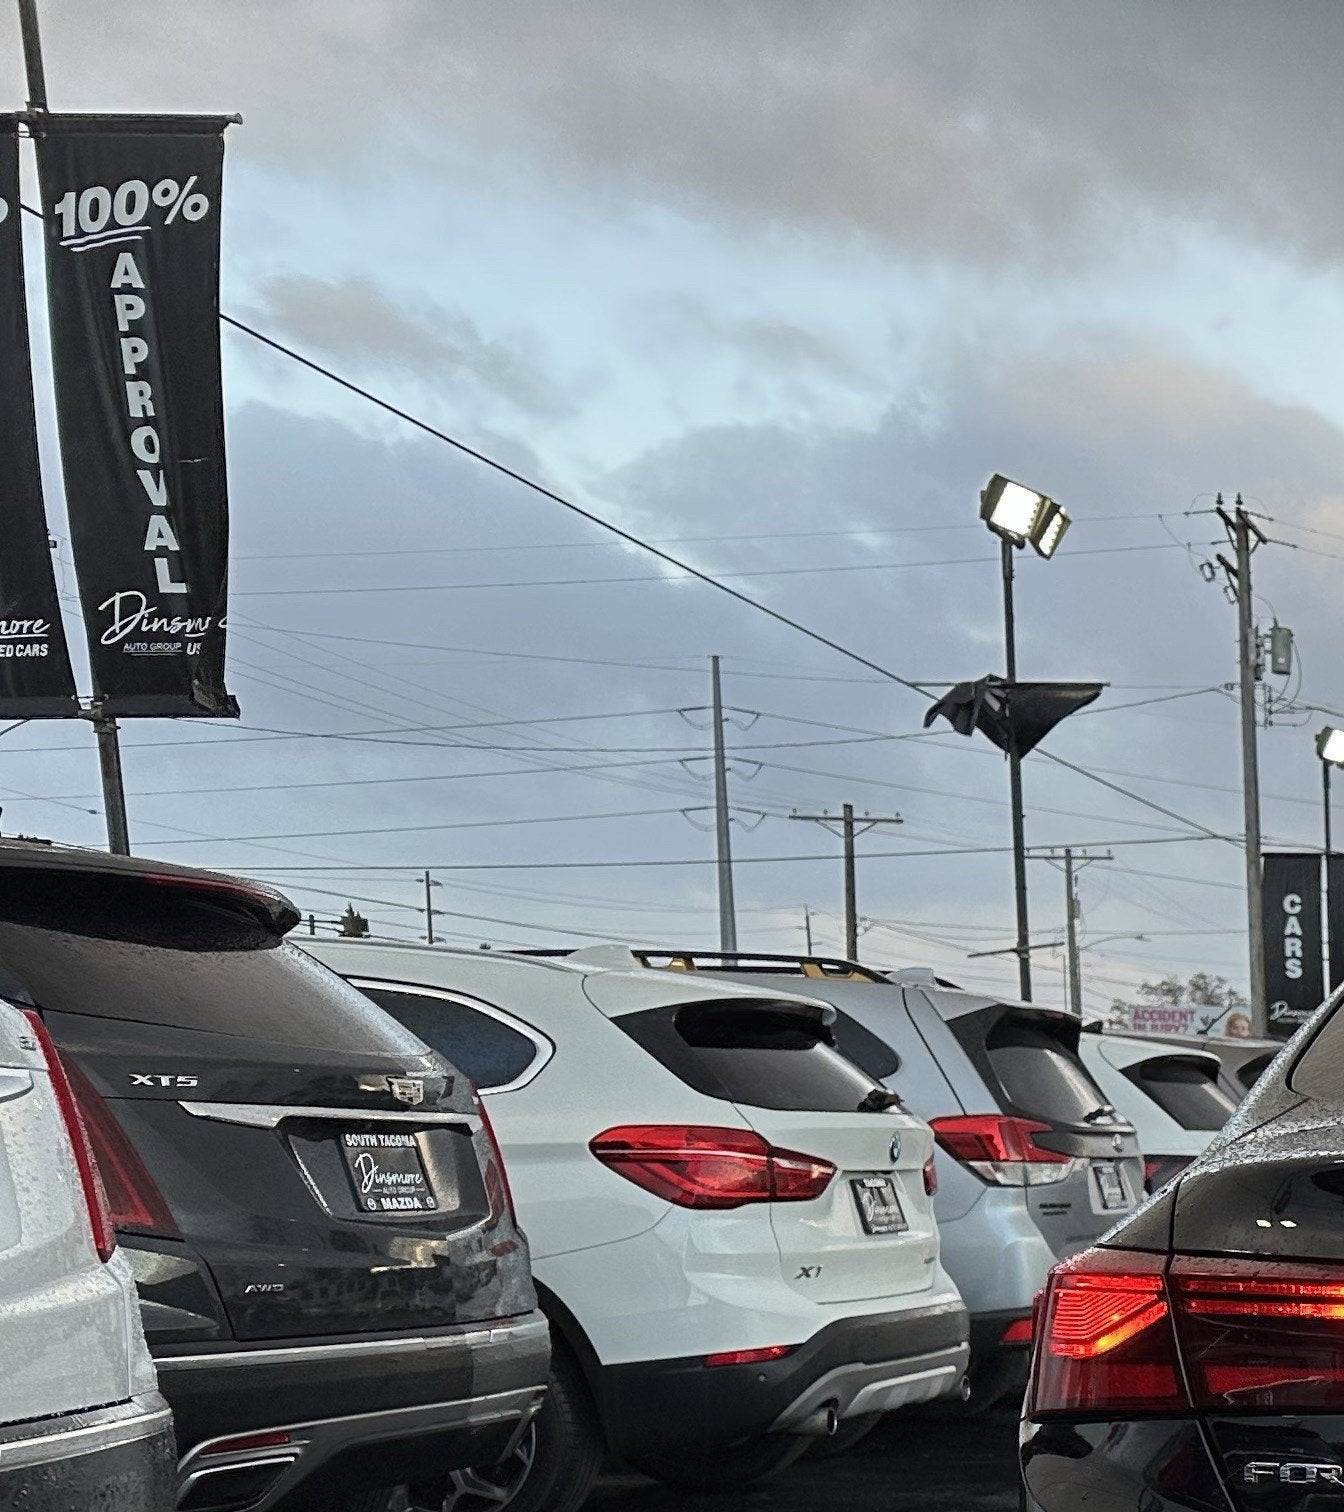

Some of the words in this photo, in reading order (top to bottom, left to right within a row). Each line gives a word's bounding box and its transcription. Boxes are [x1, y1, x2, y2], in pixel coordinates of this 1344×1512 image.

[55, 176, 209, 237] 100%
[110, 253, 187, 593] APPROVAL
[16, 644, 48, 657] CARS
[124, 642, 148, 651] AUTO
[150, 642, 182, 651] GROUP
[1283, 893, 1303, 979] CARS
[129, 1074, 198, 1087] XT5
[345, 1133, 377, 1147] SOUTH
[379, 1134, 416, 1147] TACOMA
[354, 1153, 422, 1193] Dinsmore
[381, 1197, 422, 1209] MAZDA
[795, 1266, 822, 1279] X1
[244, 1284, 284, 1293] AWD
